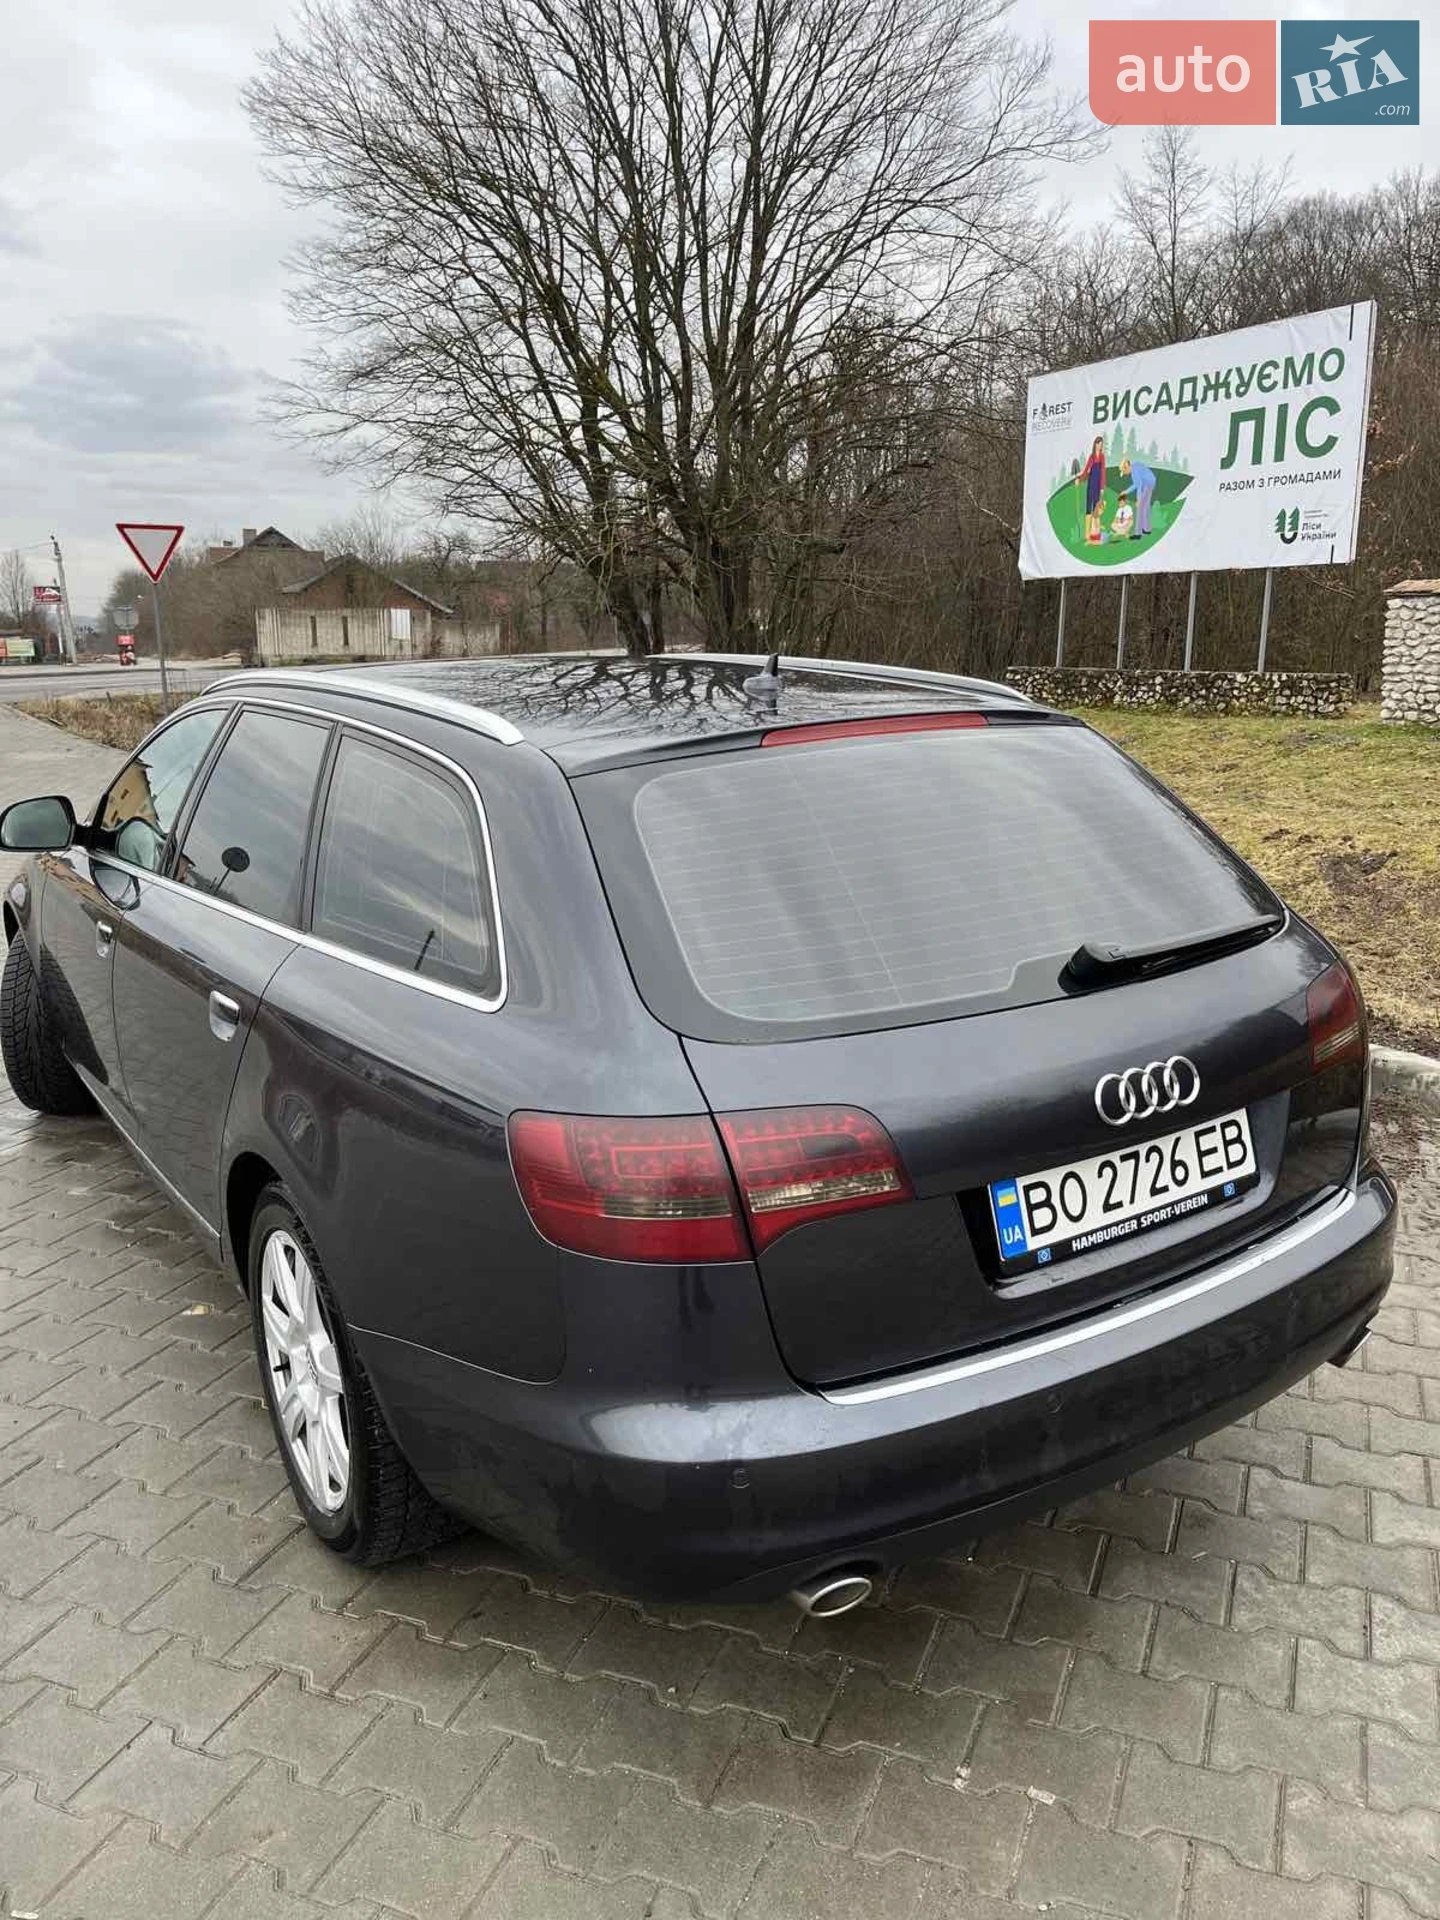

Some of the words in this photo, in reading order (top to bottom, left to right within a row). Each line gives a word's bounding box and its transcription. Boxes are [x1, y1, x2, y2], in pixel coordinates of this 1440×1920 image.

[1093, 347, 1345, 425] ВИСАДЖУЄМО
[1220, 395, 1342, 470] ЛІС
[1219, 479, 1255, 492] РАЗОМ
[1267, 469, 1342, 487] ГРОМАДАМИ
[1301, 531, 1337, 543] України
[1302, 522, 1322, 532] Ліси
[1022, 1171, 1088, 1237] BO
[1097, 1136, 1190, 1213] 2726
[1194, 1119, 1248, 1179] EB
[1003, 1224, 1024, 1245] UA
[1072, 1219, 1138, 1252] HAMBURGER
